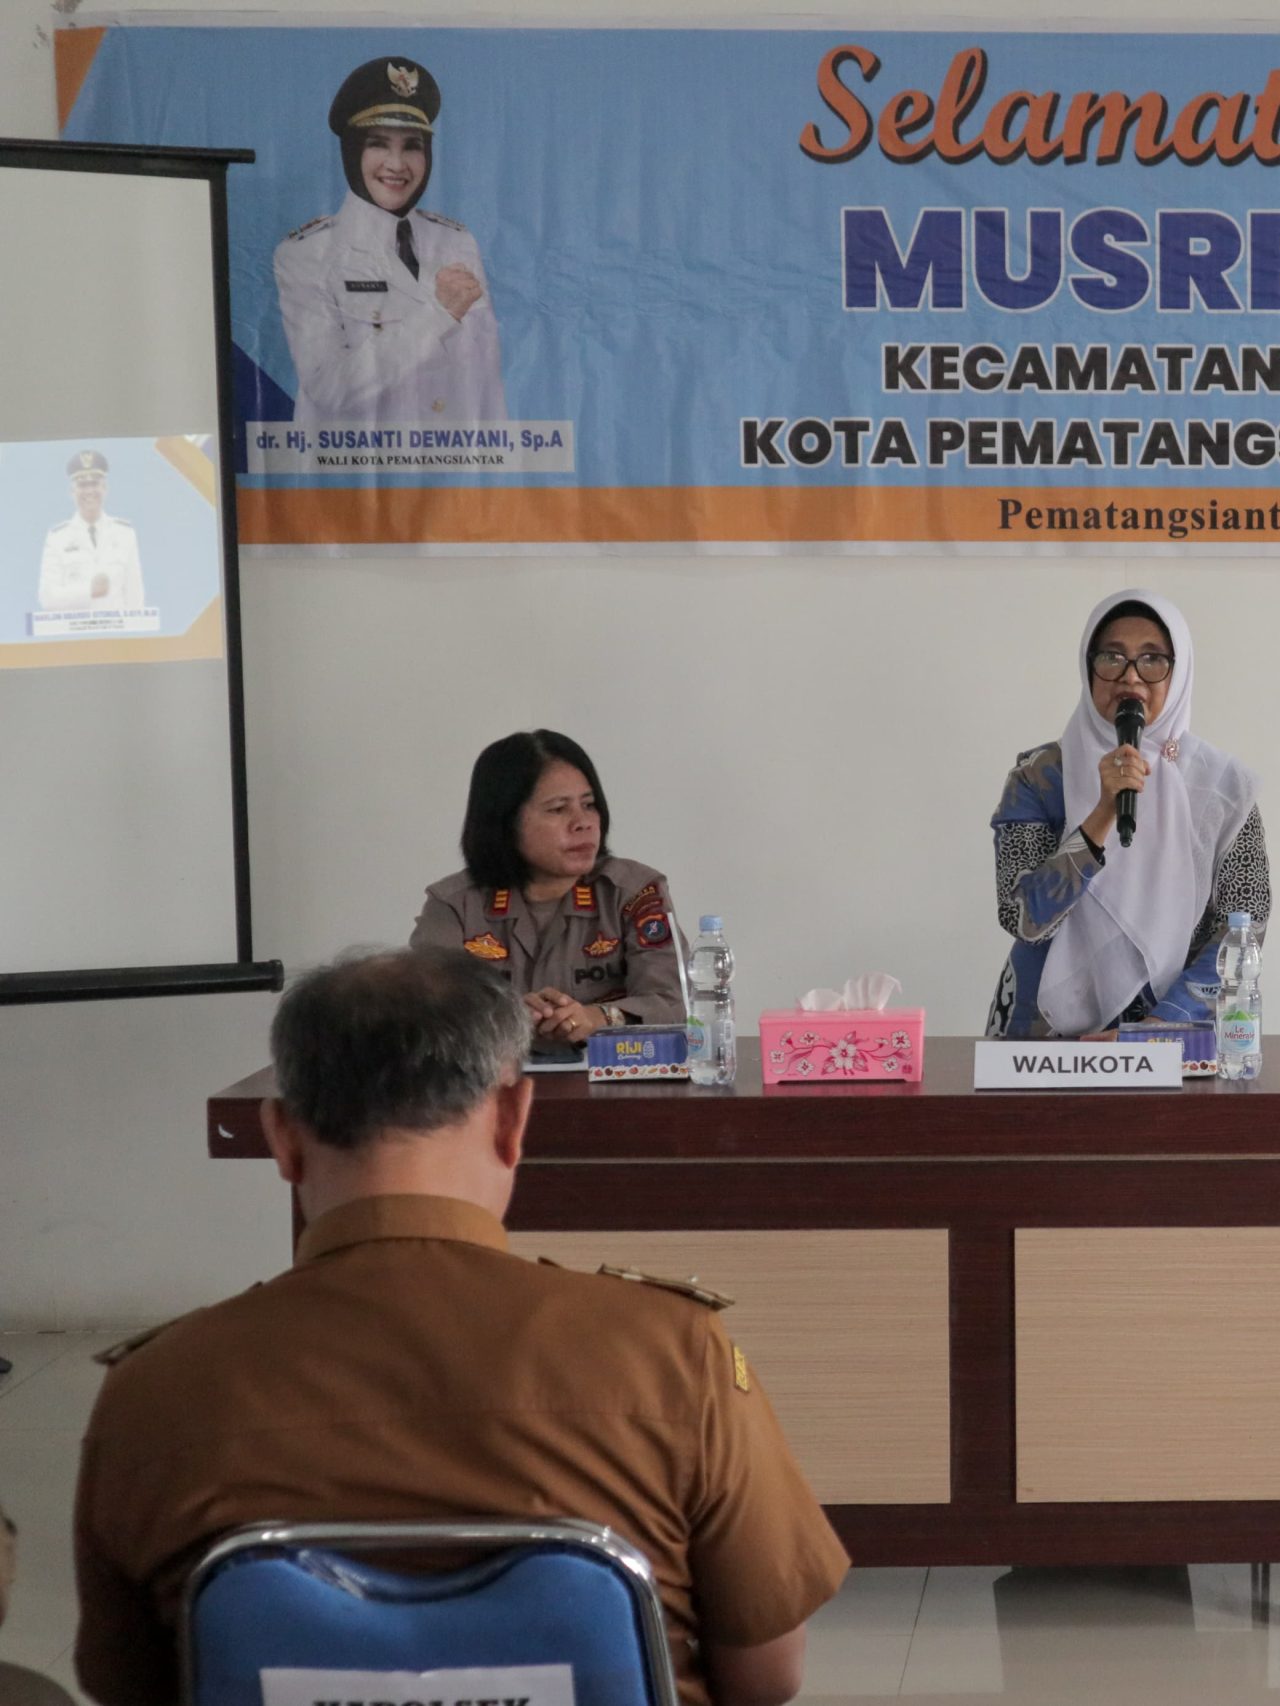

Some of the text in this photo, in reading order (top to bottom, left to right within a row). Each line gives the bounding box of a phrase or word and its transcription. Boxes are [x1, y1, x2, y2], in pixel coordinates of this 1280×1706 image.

[256, 430, 563, 453] dr. Hj. SUSANTI DEWAYANI, Sp.A
[740, 417, 920, 467] KOTA
[317, 454, 504, 466] WALI KOTA PEMATANGSIANTAR
[1012, 1054, 1154, 1075] WALIKOTA
